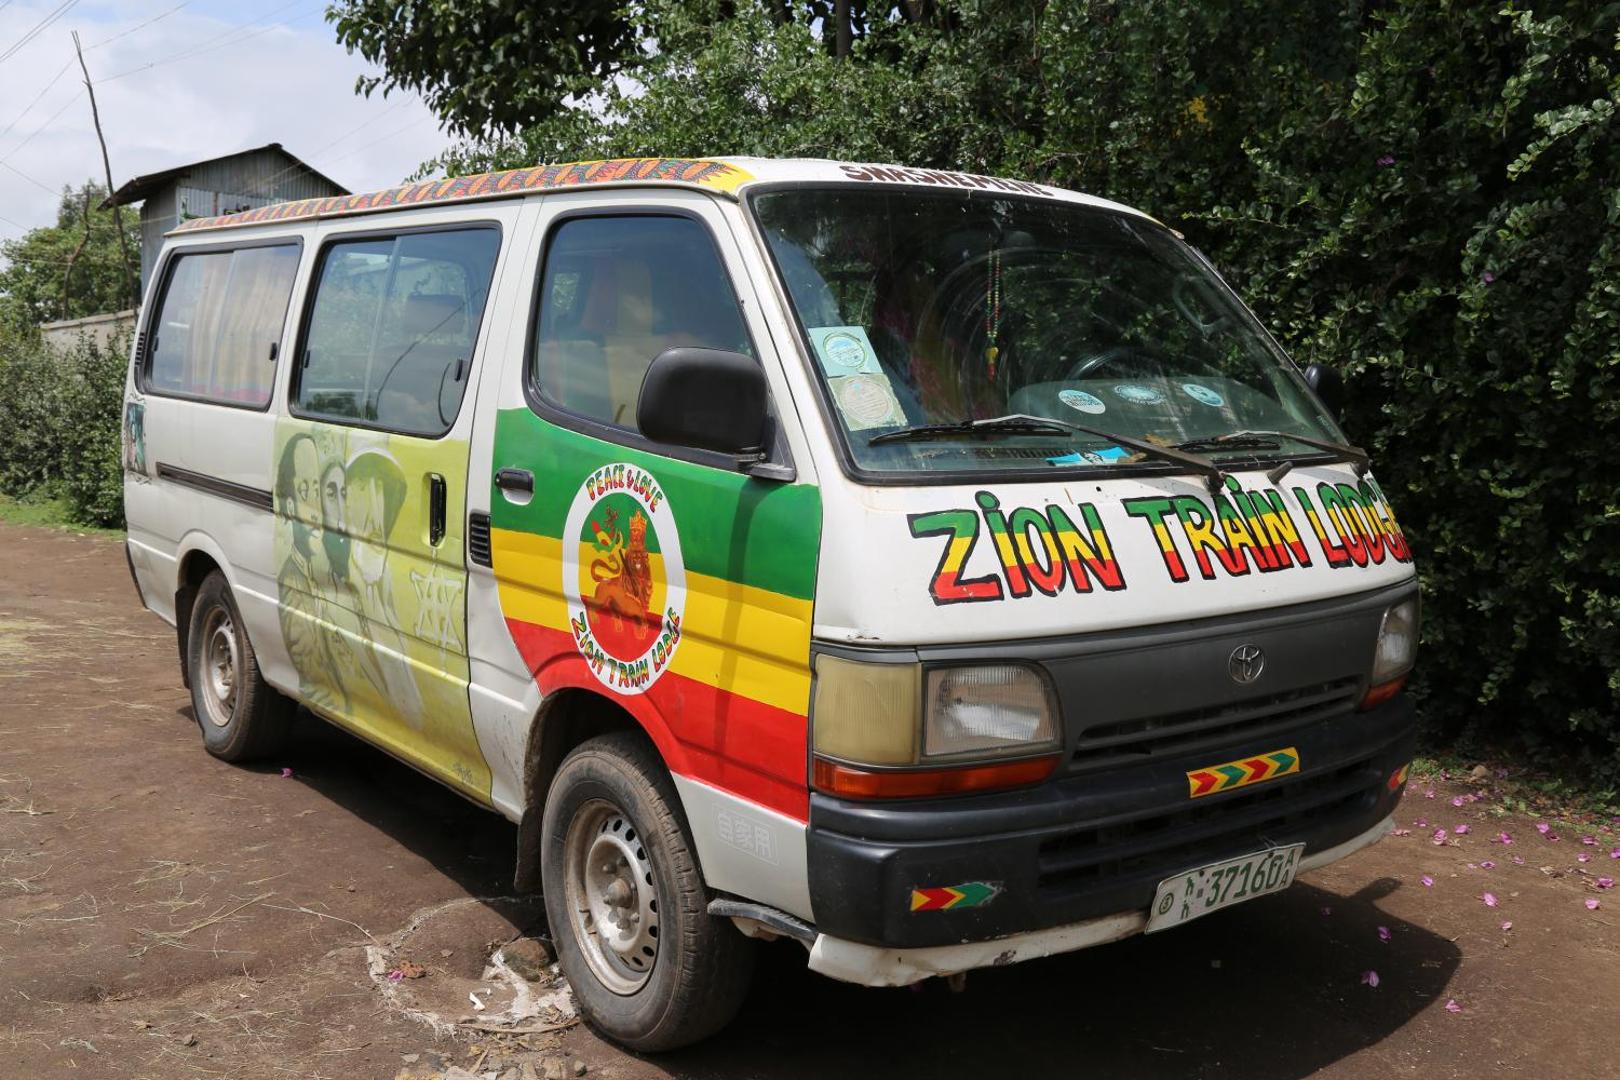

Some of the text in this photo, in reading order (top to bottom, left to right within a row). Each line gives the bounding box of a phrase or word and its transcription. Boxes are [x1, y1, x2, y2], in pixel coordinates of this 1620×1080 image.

[585, 464, 625, 501] PEACE
[633, 470, 663, 513] LOVE
[652, 606, 680, 673] LODGE
